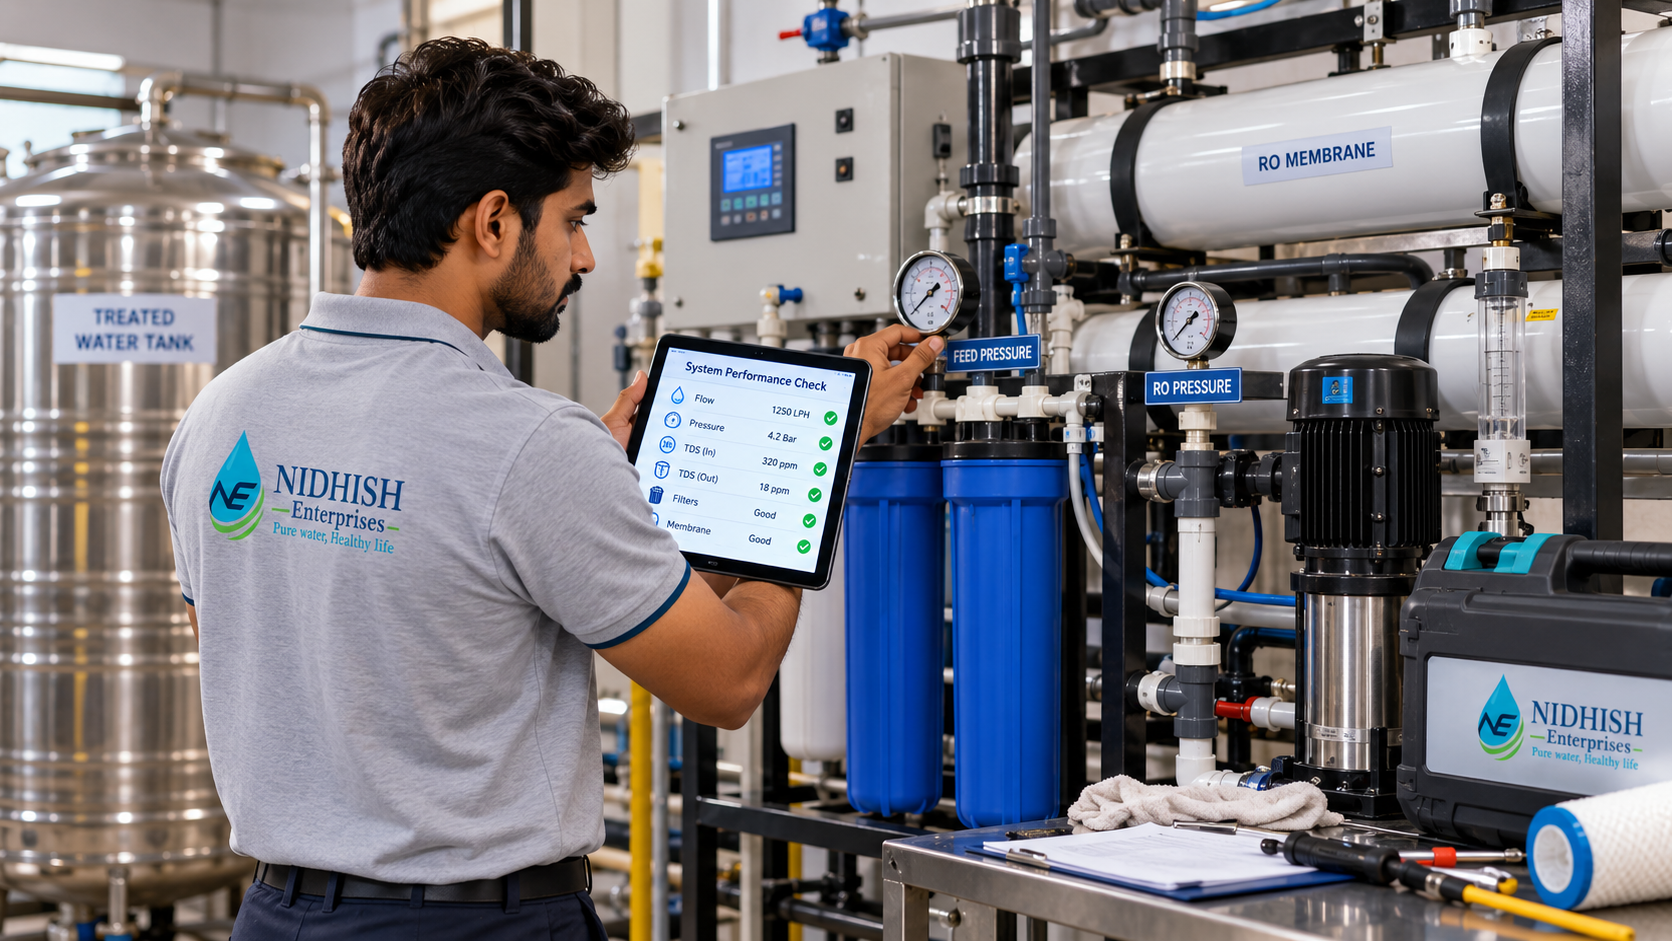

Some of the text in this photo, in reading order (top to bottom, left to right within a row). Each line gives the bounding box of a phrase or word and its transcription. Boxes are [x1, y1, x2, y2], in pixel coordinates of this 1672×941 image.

[1258, 141, 1376, 172] RO MEMBRANE
[93, 308, 175, 326] TREATED
[74, 333, 195, 352] WATER TANK
[953, 345, 1032, 363] FEED PRESSURE
[685, 361, 827, 392] System Performance Check
[1153, 378, 1232, 396] RO PRESSURE
[694, 394, 811, 419] Flow 1250 LPH
[689, 419, 797, 444] Pressure 4.2 Bar
[684, 444, 700, 455] TDS
[702, 446, 716, 458] (In)
[761, 457, 778, 468] 320
[779, 460, 798, 471] ppm
[273, 464, 405, 512] NIDHISH
[678, 469, 790, 496] TDS (Out) 18 ppm
[291, 500, 385, 533] Enterprises
[672, 494, 777, 520] Filters Good
[273, 521, 395, 554] Pure water, Healthy life
[666, 520, 772, 546] Membrane Good
[1531, 700, 1643, 737] NIDHISH
[1546, 728, 1632, 754] Enterprises
[1531, 746, 1639, 771] Pure water, Healthy life
